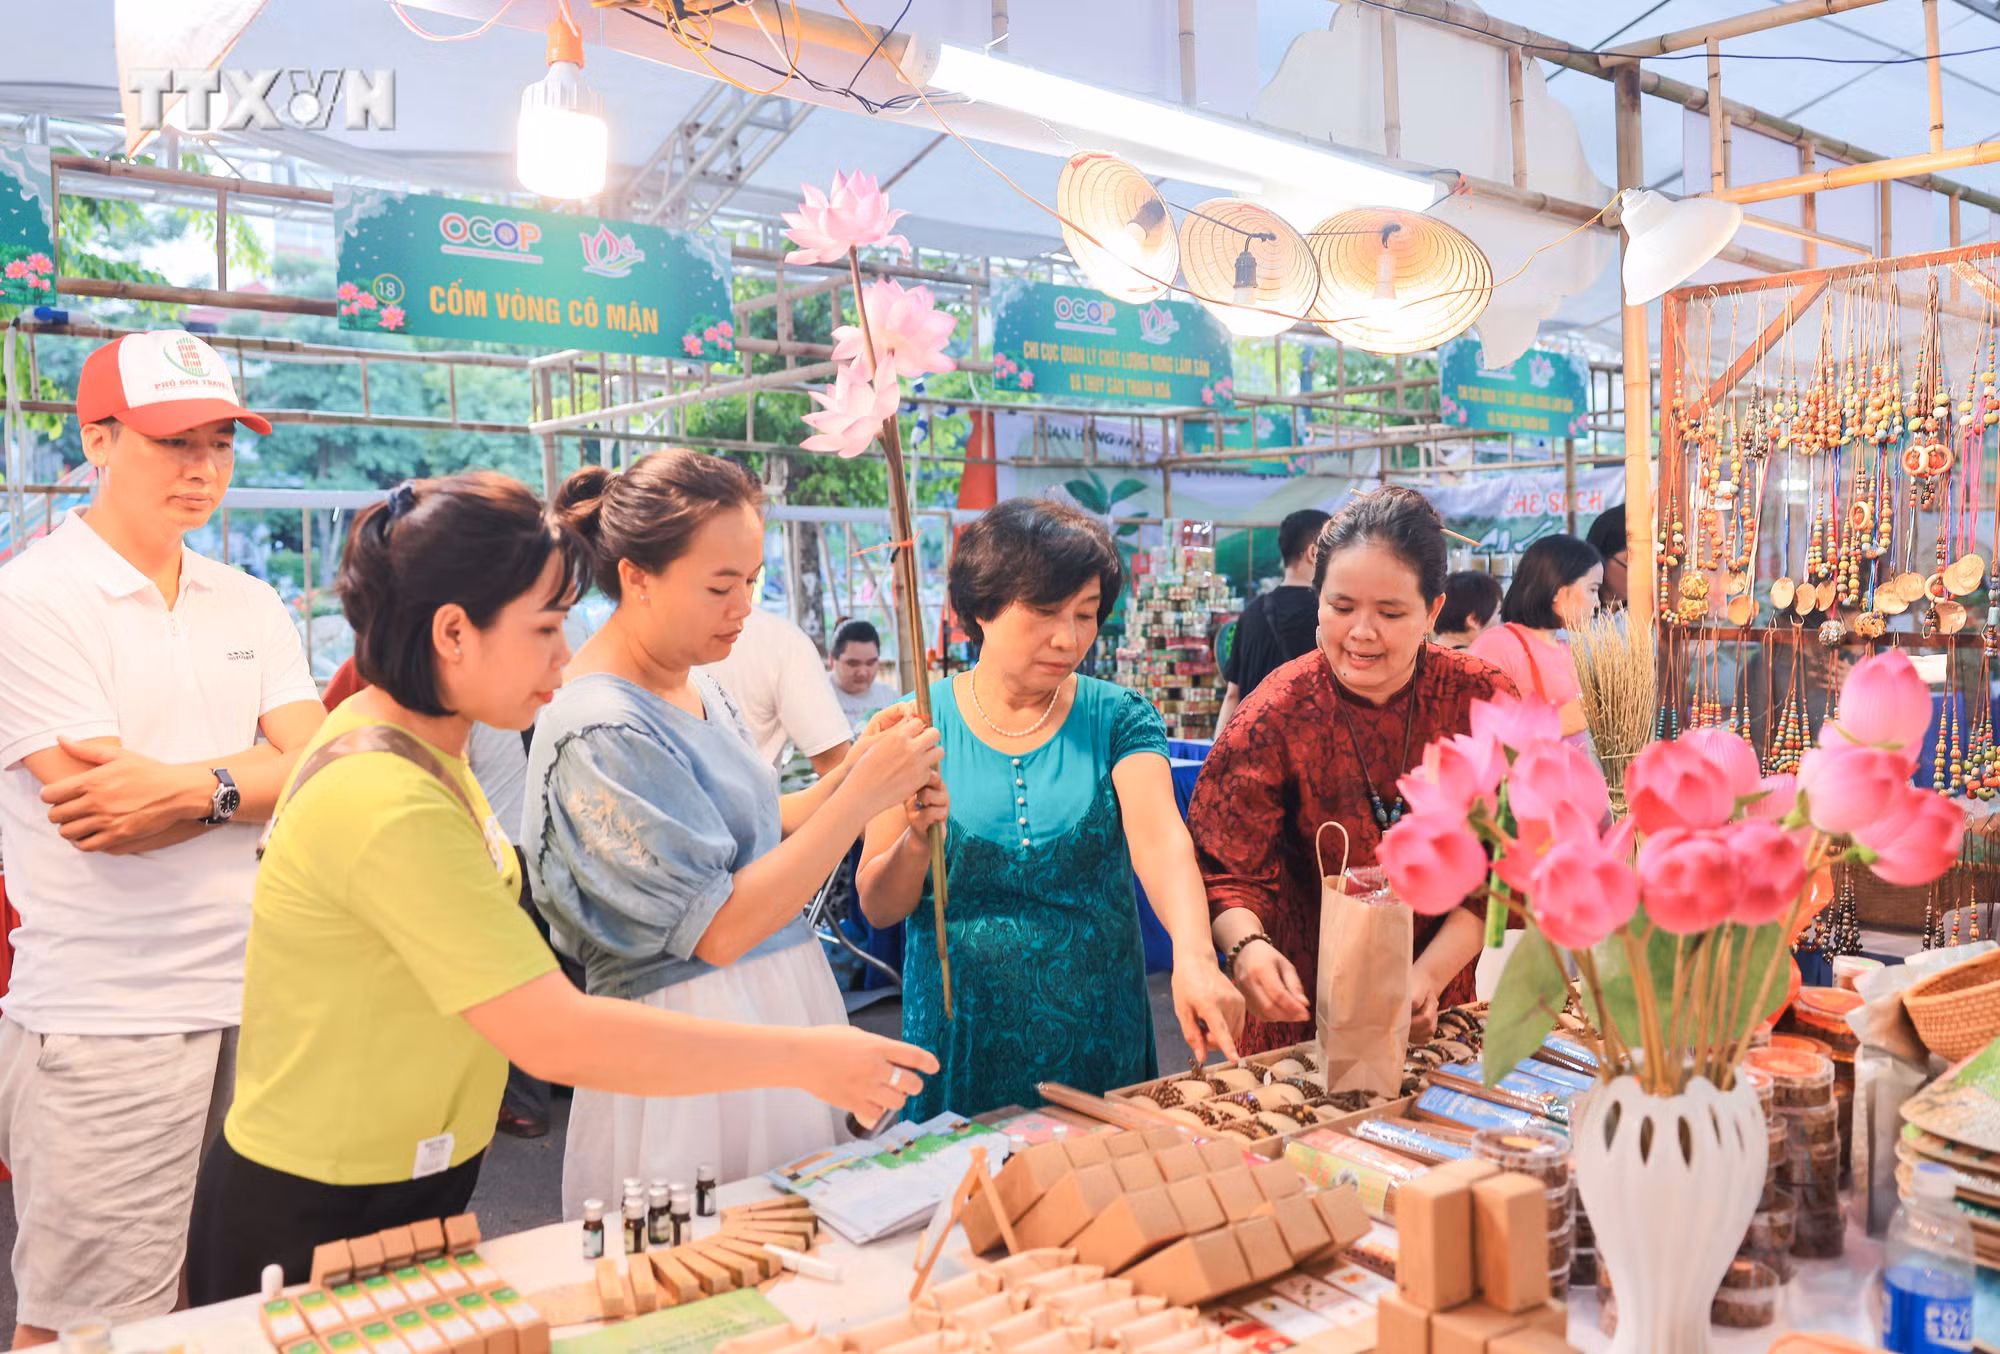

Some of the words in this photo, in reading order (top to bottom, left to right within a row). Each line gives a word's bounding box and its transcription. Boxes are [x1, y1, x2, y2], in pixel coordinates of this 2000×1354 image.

[439, 212, 541, 252] OCOP
[378, 281, 396, 298] 18
[429, 278, 488, 319] CỐM
[494, 287, 561, 325] VÒNG
[568, 296, 599, 329] CÔ
[606, 301, 659, 338] MẬN
[1055, 296, 1116, 324] OCOP
